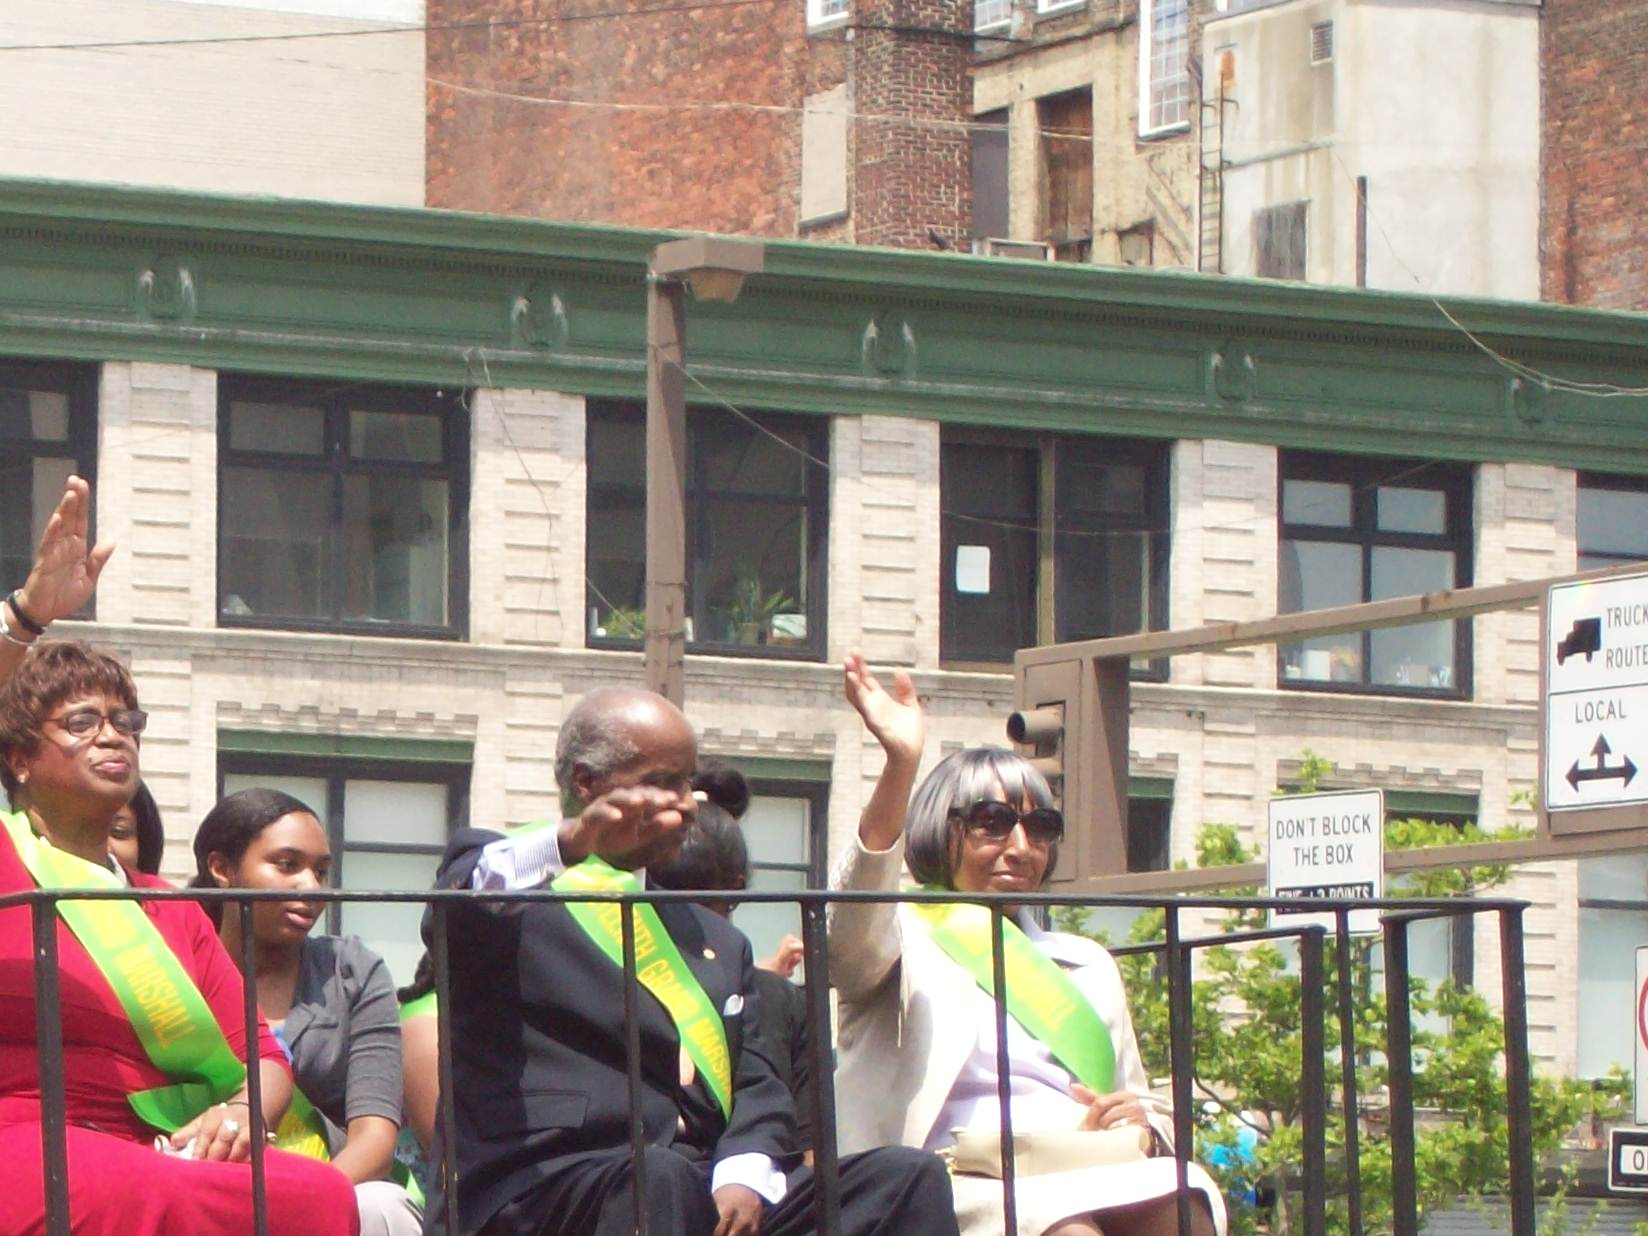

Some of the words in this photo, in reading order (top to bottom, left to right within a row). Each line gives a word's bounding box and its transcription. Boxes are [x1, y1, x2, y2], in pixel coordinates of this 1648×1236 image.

[1606, 603, 1648, 630] TRUCK
[1574, 699, 1627, 724] LOCAL
[1322, 813, 1371, 837] BLOCK
[1293, 846, 1319, 867] THE
[1325, 843, 1353, 865] BOX
